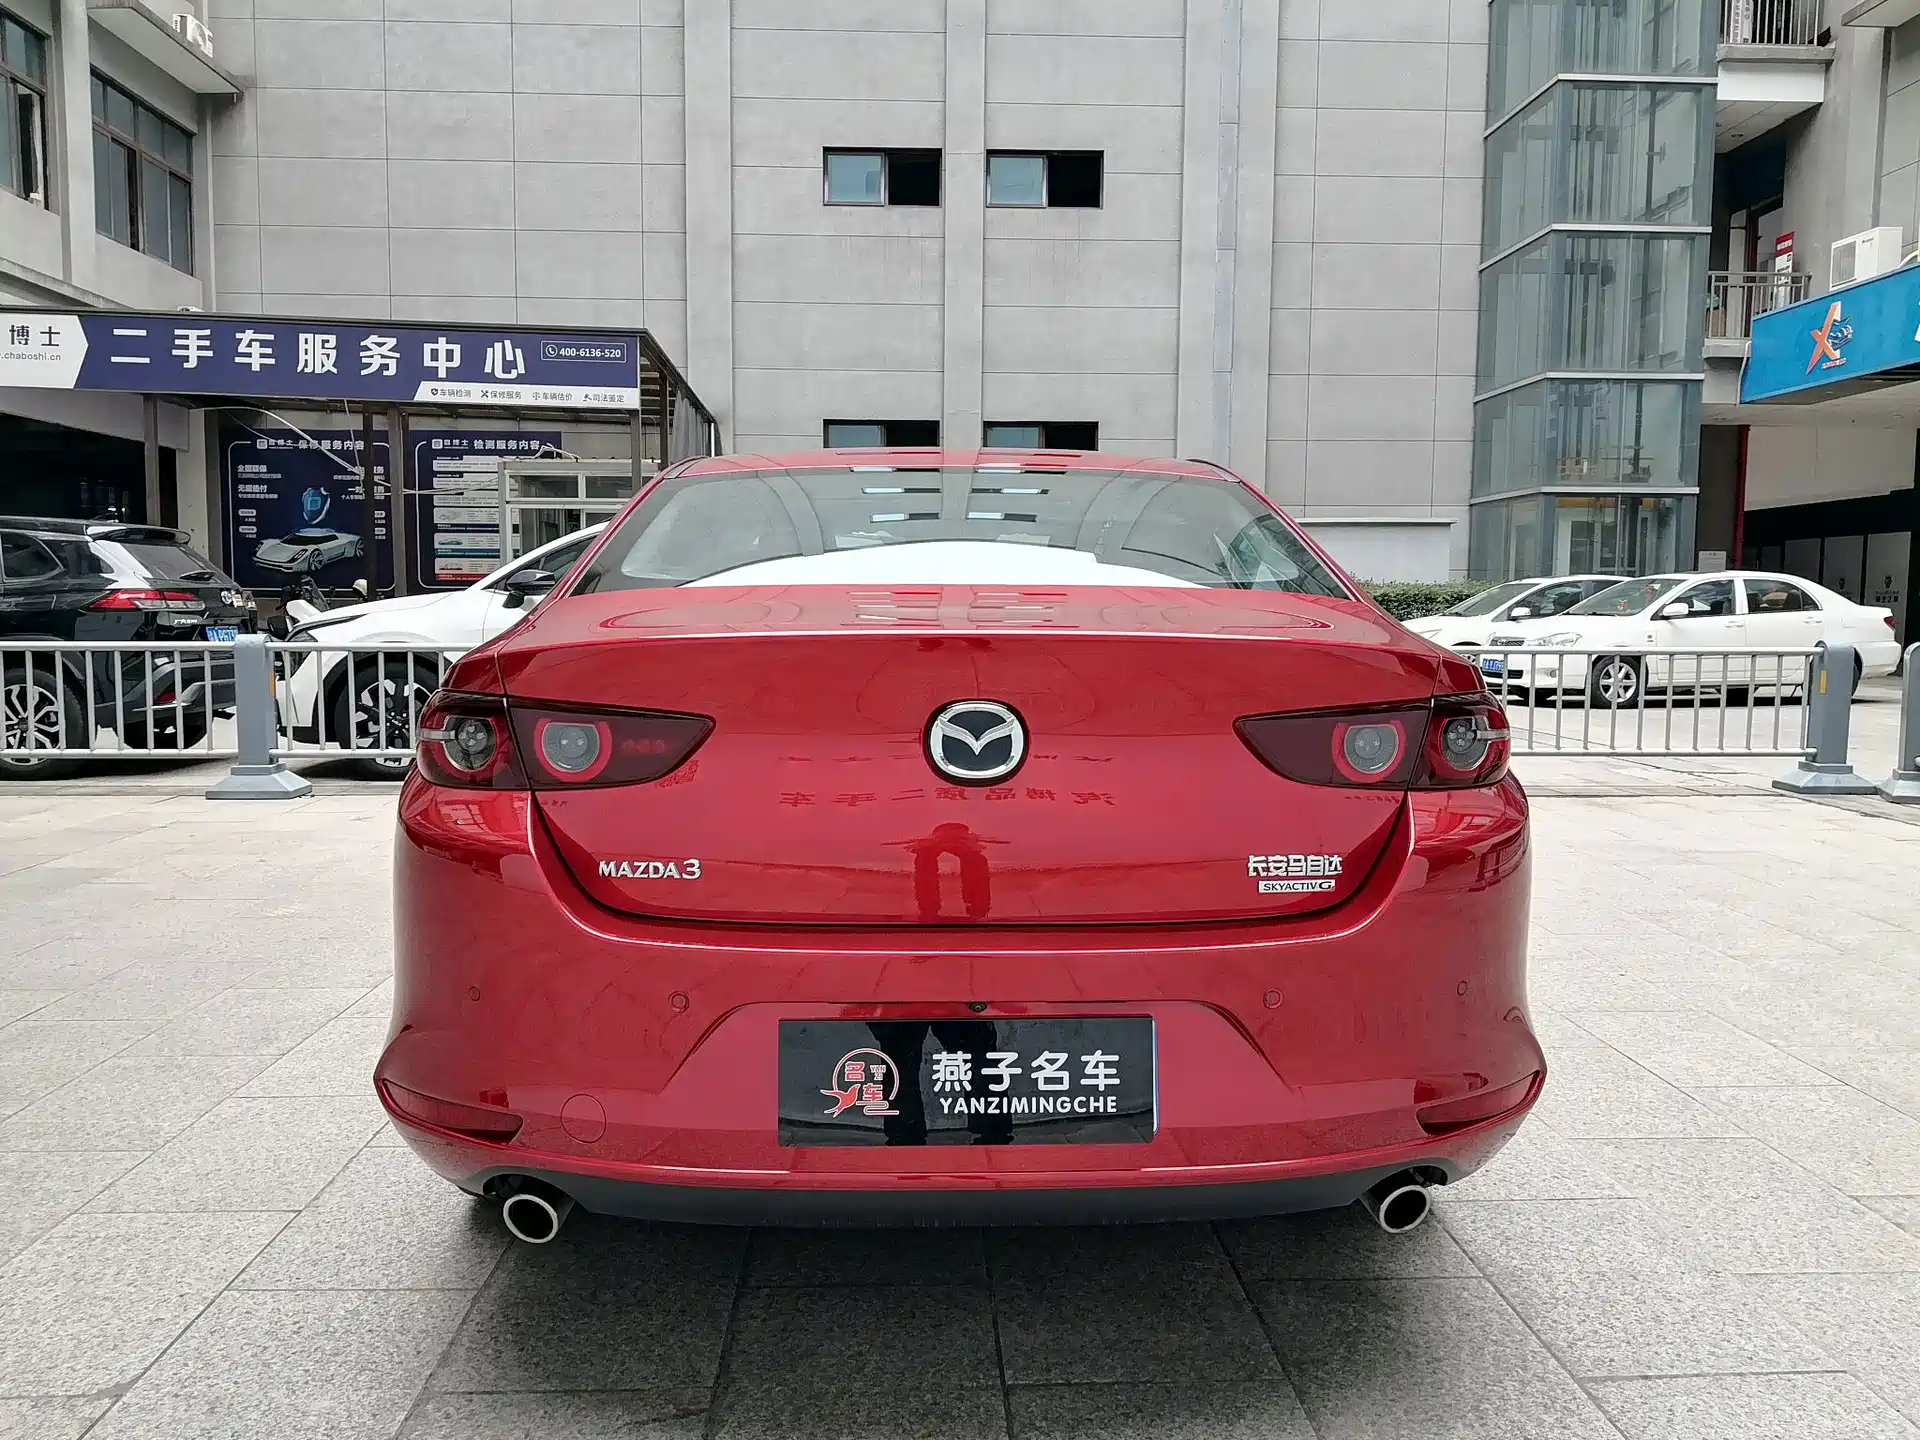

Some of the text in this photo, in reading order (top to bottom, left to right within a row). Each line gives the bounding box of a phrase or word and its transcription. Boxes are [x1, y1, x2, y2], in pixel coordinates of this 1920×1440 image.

[9, 324, 61, 347] 博士
[0, 351, 61, 361] .chaboshi.cn
[110, 328, 526, 380] 二手车服务中心
[559, 347, 622, 358] 400-6136-520
[439, 388, 472, 398] 车辆检测
[490, 390, 522, 400] 保修服务
[541, 391, 573, 402] 车辆估价
[473, 439, 540, 450] 检测服务内容
[598, 858, 701, 879] MAZDA3
[1247, 854, 1343, 877] 长安马自达
[931, 1050, 1121, 1092] 燕子名车
[940, 1096, 1117, 1115] YANZIMINGCHE
